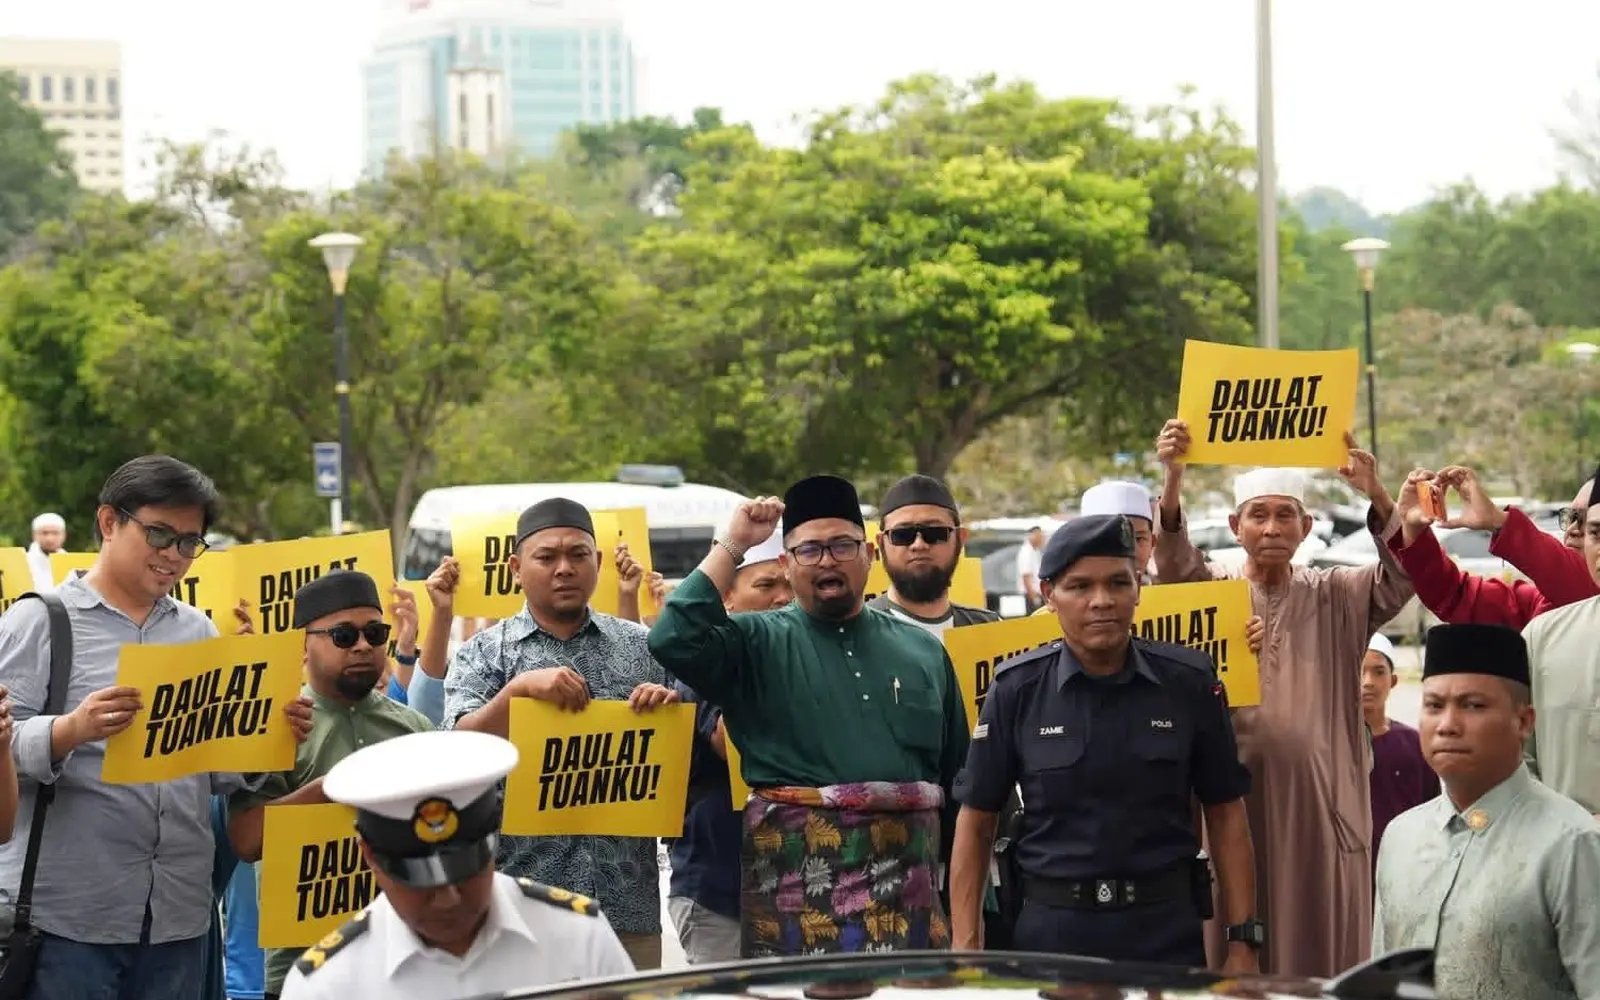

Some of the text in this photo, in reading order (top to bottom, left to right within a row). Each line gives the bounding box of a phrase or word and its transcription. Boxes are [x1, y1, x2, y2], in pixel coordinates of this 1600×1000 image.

[1212, 375, 1323, 411] DAULAT
[1207, 406, 1327, 443] TUANKU!
[1131, 606, 1217, 645] AULAT
[149, 662, 268, 721] DAULAT
[143, 698, 273, 759] TUANKU!
[1151, 720, 1173, 728] POLIS
[542, 729, 655, 774] DAULAT
[538, 765, 661, 811] TUANKU!
[297, 872, 382, 922] TUAN
